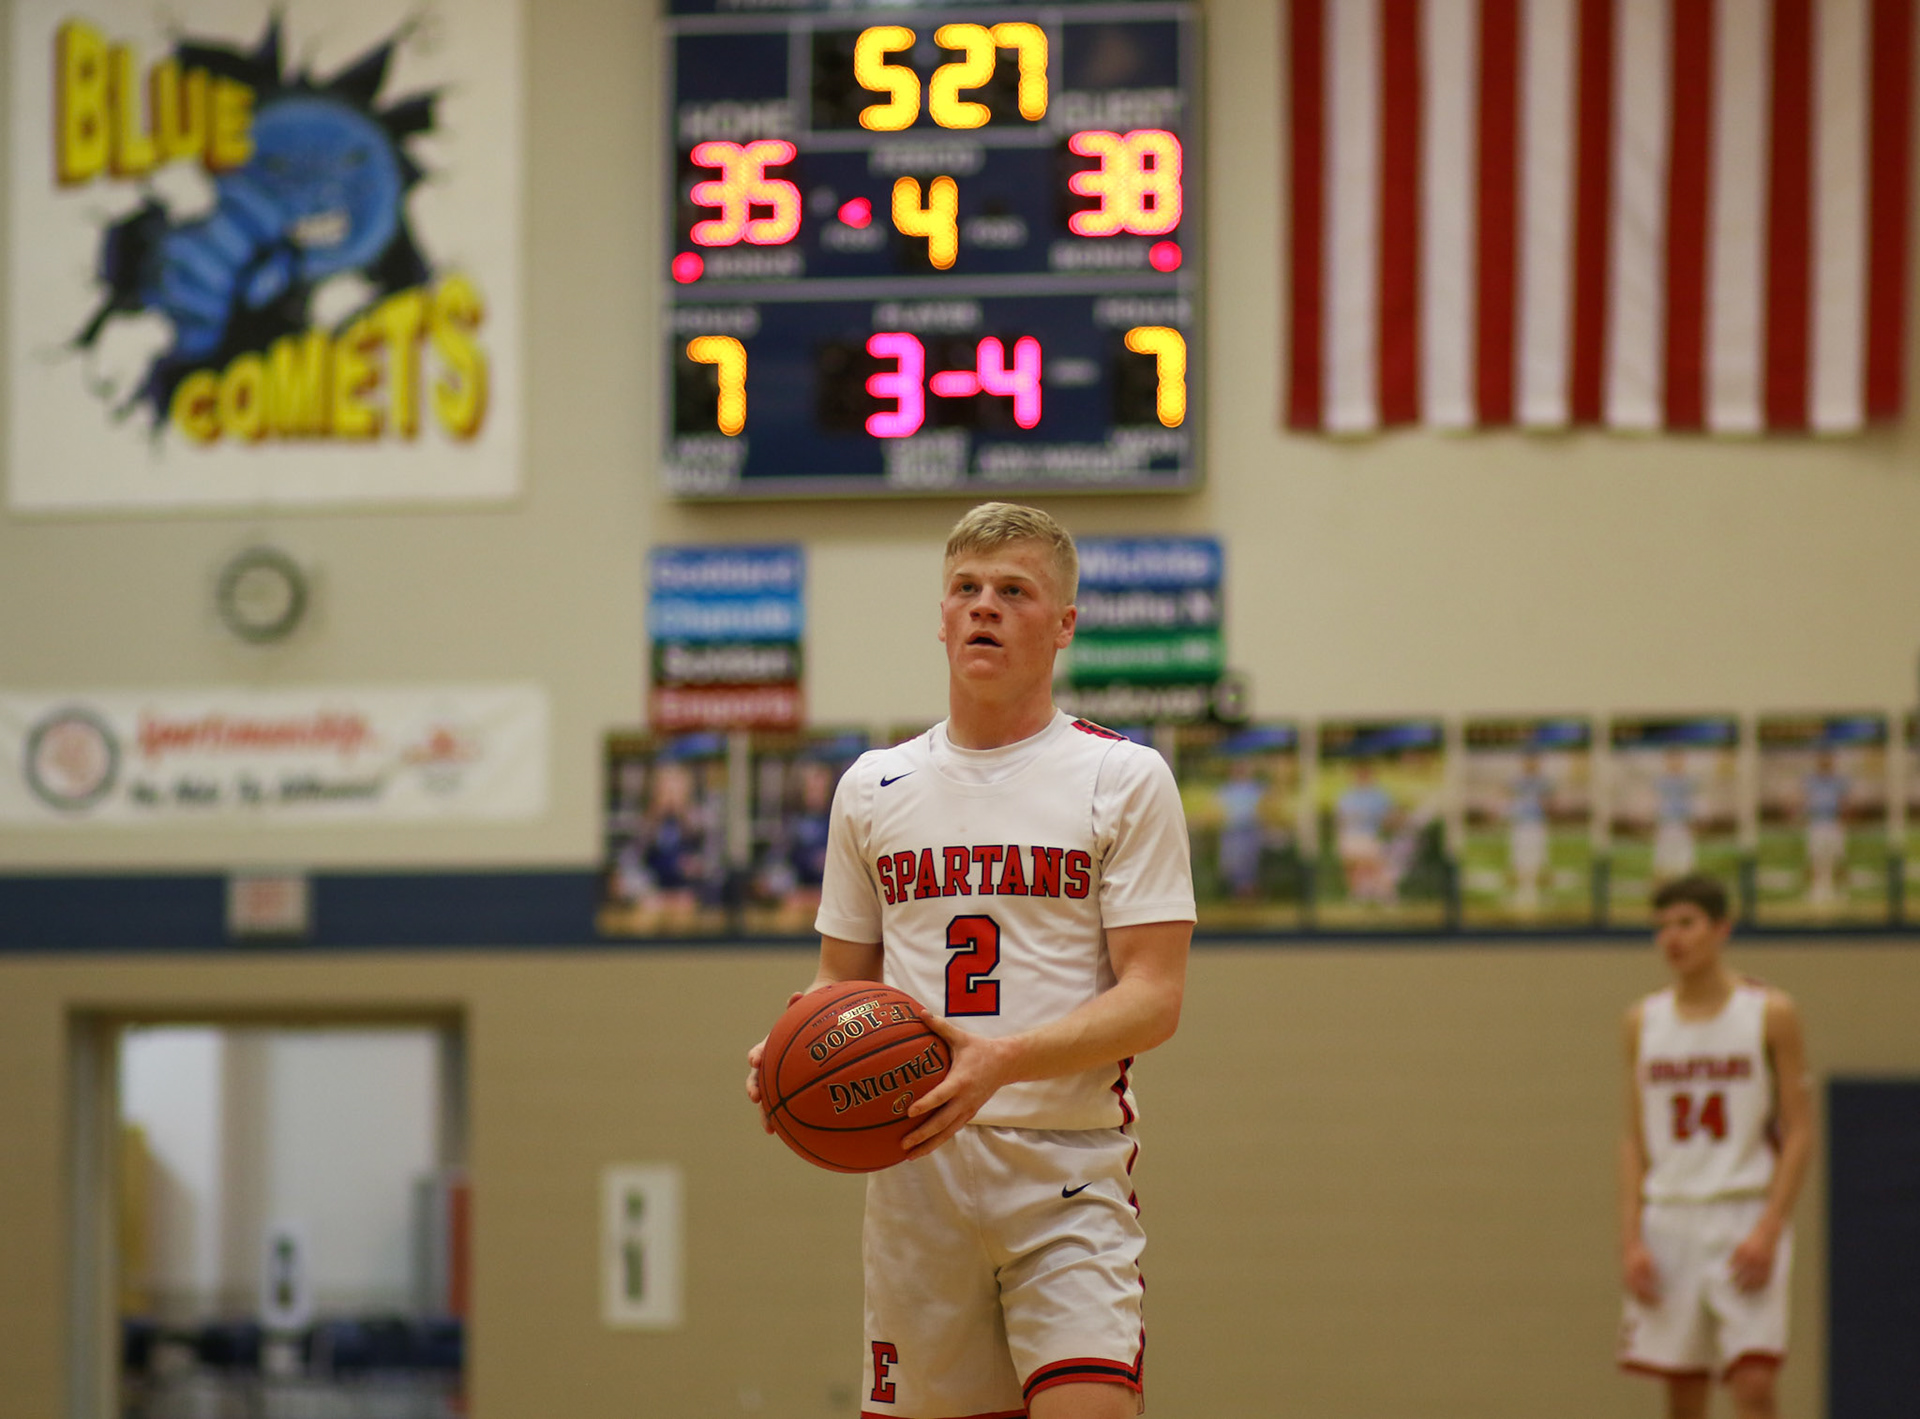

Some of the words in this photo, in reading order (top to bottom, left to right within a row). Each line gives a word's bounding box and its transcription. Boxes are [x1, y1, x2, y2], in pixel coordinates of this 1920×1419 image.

[55, 16, 255, 190] BLUE
[690, 139, 802, 246] 35
[892, 176, 958, 270] 4
[1068, 129, 1183, 236] 38
[170, 274, 490, 445] COMETS
[687, 335, 747, 437] 7
[1125, 326, 1187, 428] 7
[877, 845, 1092, 905] SPARTANS
[837, 1000, 880, 1026] LEGACY
[945, 914, 1001, 1017] 2
[828, 1041, 945, 1114] SPALDING
[870, 1339, 899, 1403] E
